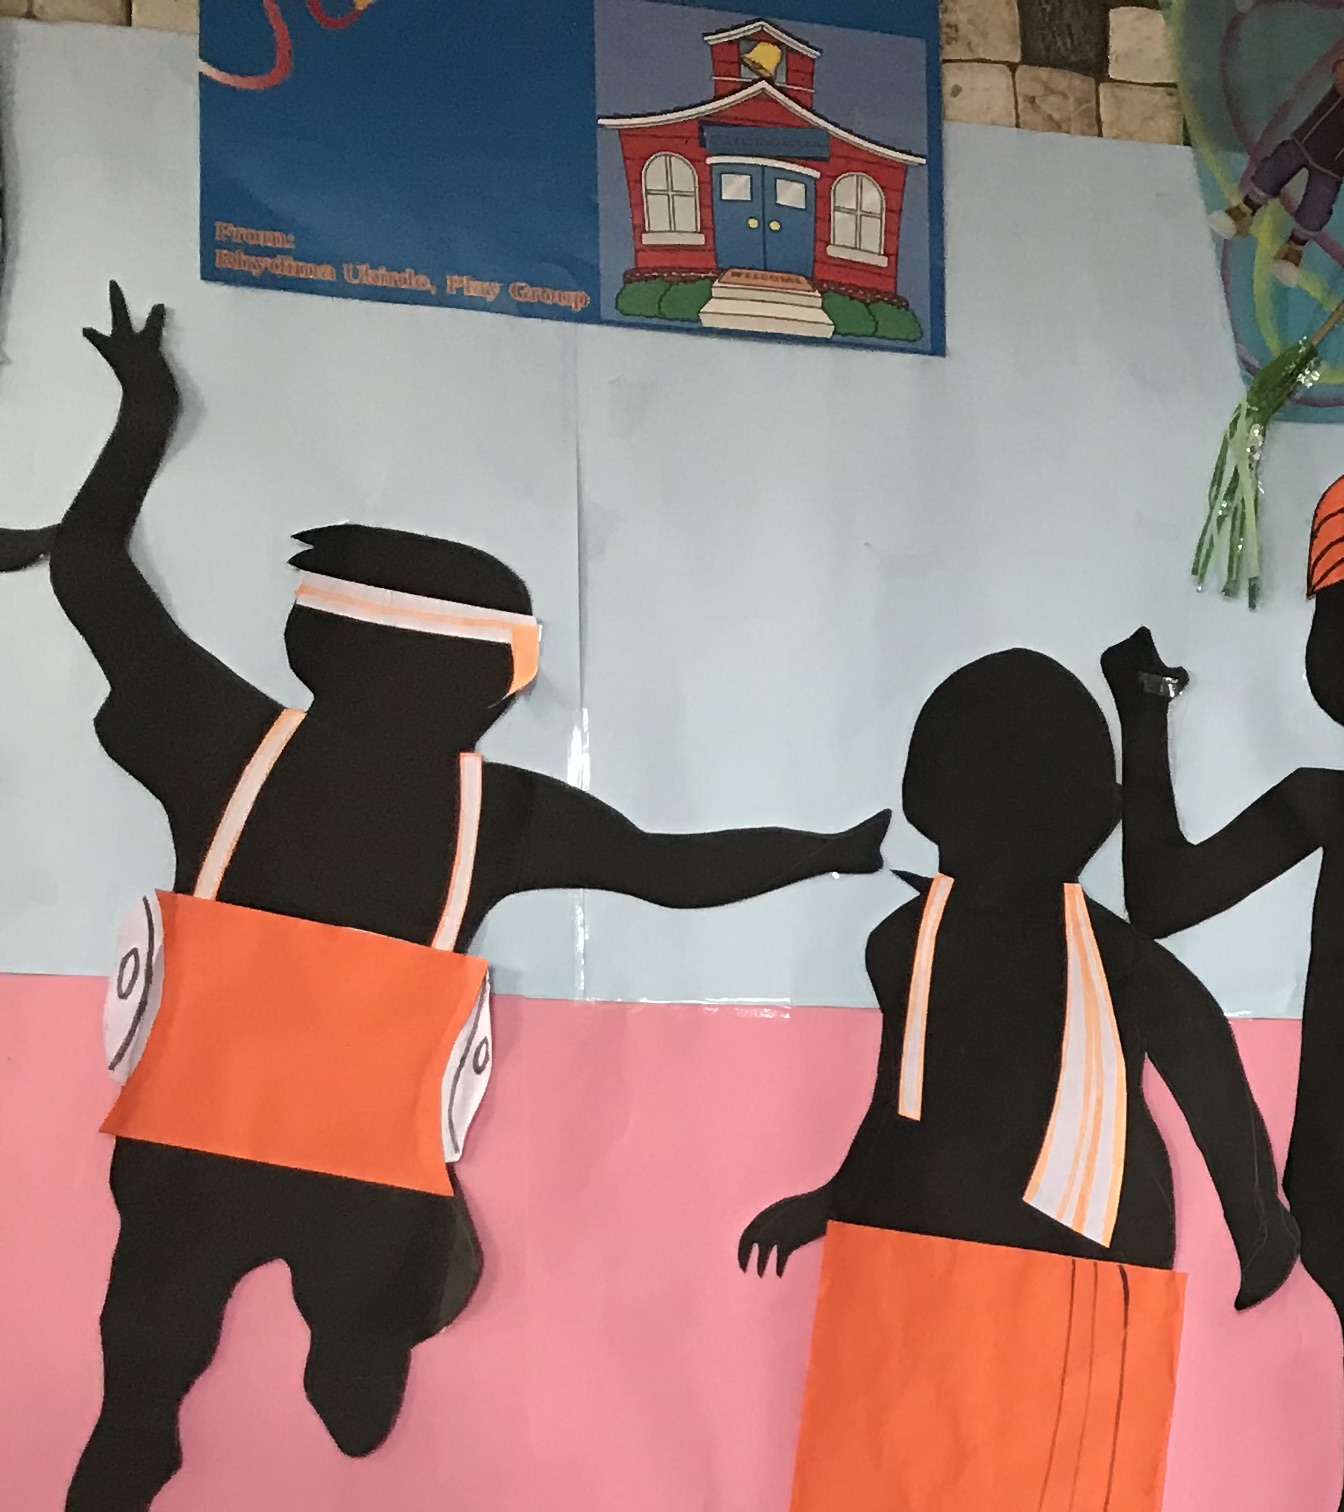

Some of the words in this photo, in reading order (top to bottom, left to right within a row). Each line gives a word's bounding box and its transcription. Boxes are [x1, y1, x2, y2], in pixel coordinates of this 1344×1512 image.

[215, 221, 295, 249] From:
[446, 274, 502, 302] Play
[508, 281, 590, 312] Group
